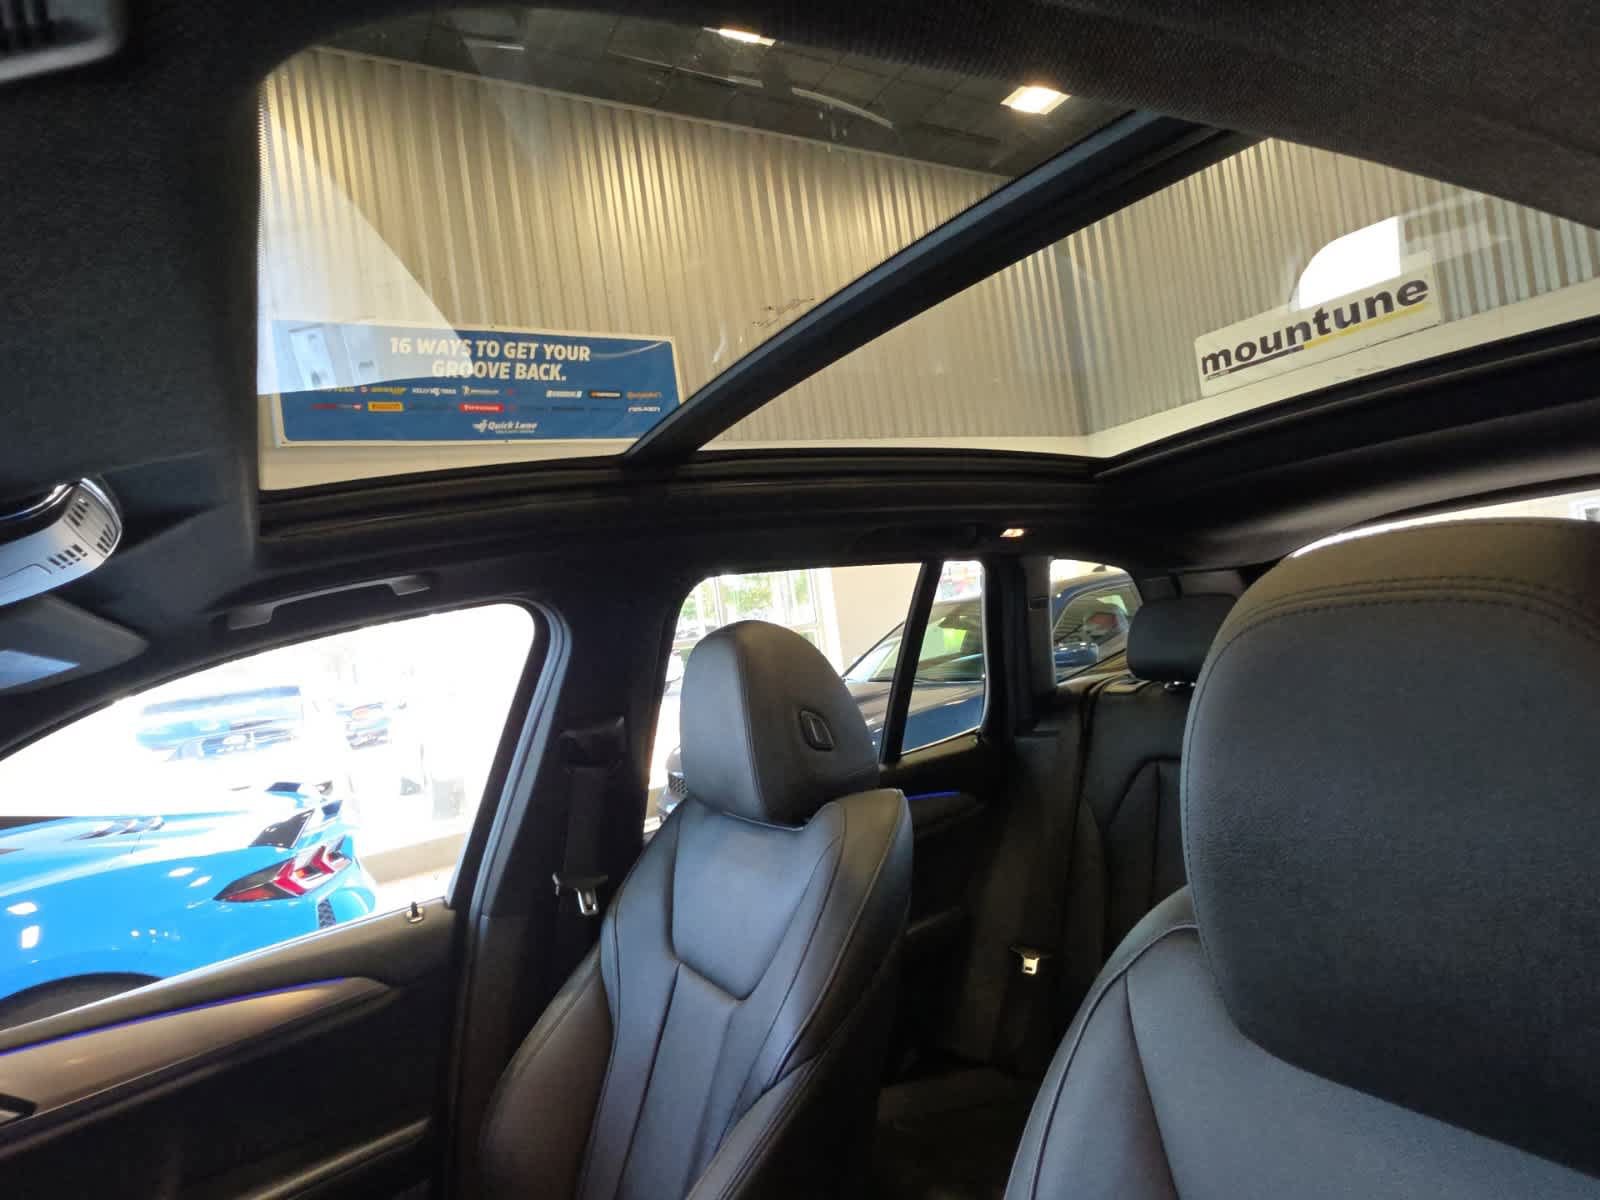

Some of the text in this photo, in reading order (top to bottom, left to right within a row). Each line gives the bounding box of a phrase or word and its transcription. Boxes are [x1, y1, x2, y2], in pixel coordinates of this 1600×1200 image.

[1201, 279, 1429, 375] mountune
[390, 337, 591, 361] 16 WAYS TO GET YOUR
[431, 360, 567, 381] GROOVE BACK.
[488, 420, 537, 432] Quick Lane
